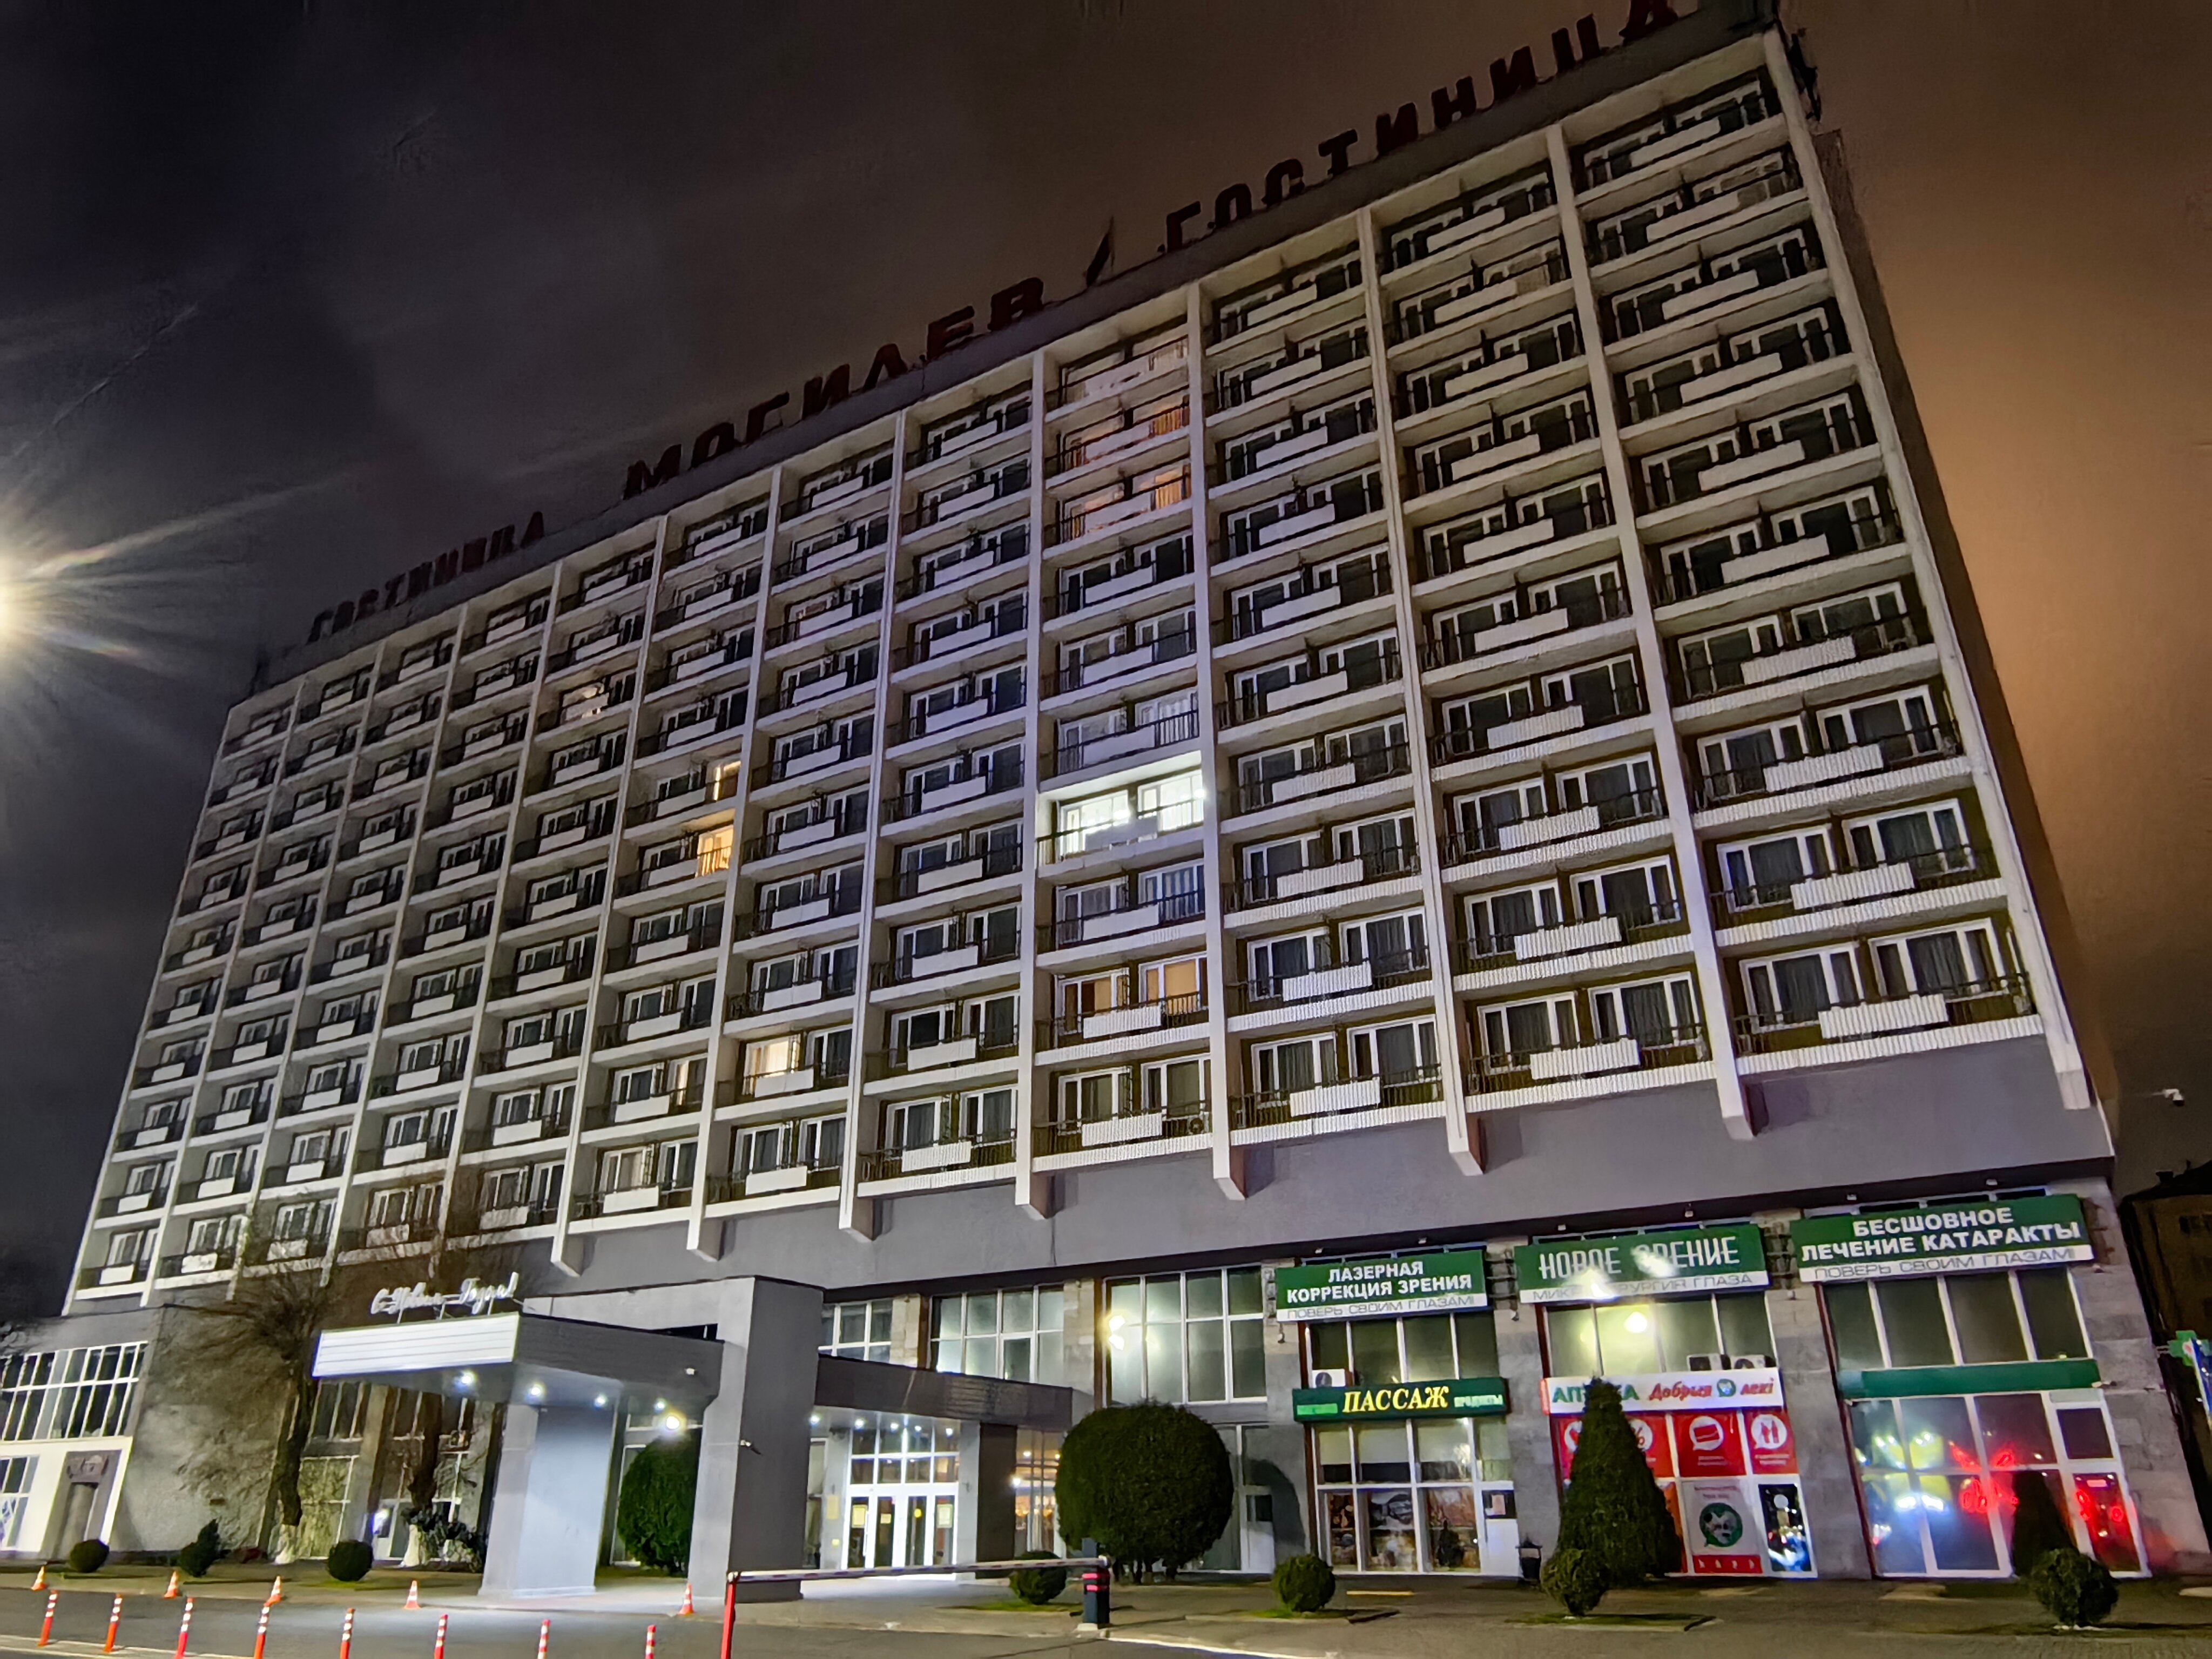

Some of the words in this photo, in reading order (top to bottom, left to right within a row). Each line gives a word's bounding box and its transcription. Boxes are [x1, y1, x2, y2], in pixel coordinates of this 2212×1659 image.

[623, 276, 1043, 500] МОГИЛЕВ
[1852, 1207, 2014, 1237] БЕСШОВНОЕ
[1801, 1237, 1917, 1262] ЛЕЧЕНИЕ
[1923, 1222, 2081, 1252] КАТАРАКТЫ
[1328, 1261, 1424, 1283] ЛАЗЕРНАЯ
[1694, 1274, 1752, 1286] ГЛАЗА
[1815, 1264, 1892, 1279] ПОВЕРЬ
[1899, 1256, 1975, 1272] СВОИМ
[1287, 1282, 1392, 1303] КОРРЕКЦИЯ
[1398, 1274, 1472, 1294] ЗРЕНИЯ
[1287, 1307, 1343, 1319] ПОВЕРЬ
[1350, 1301, 1403, 1313] СВОИМ
[1343, 1386, 1449, 1413] ПАССАЖ
[1552, 1384, 1640, 1403] АПА
